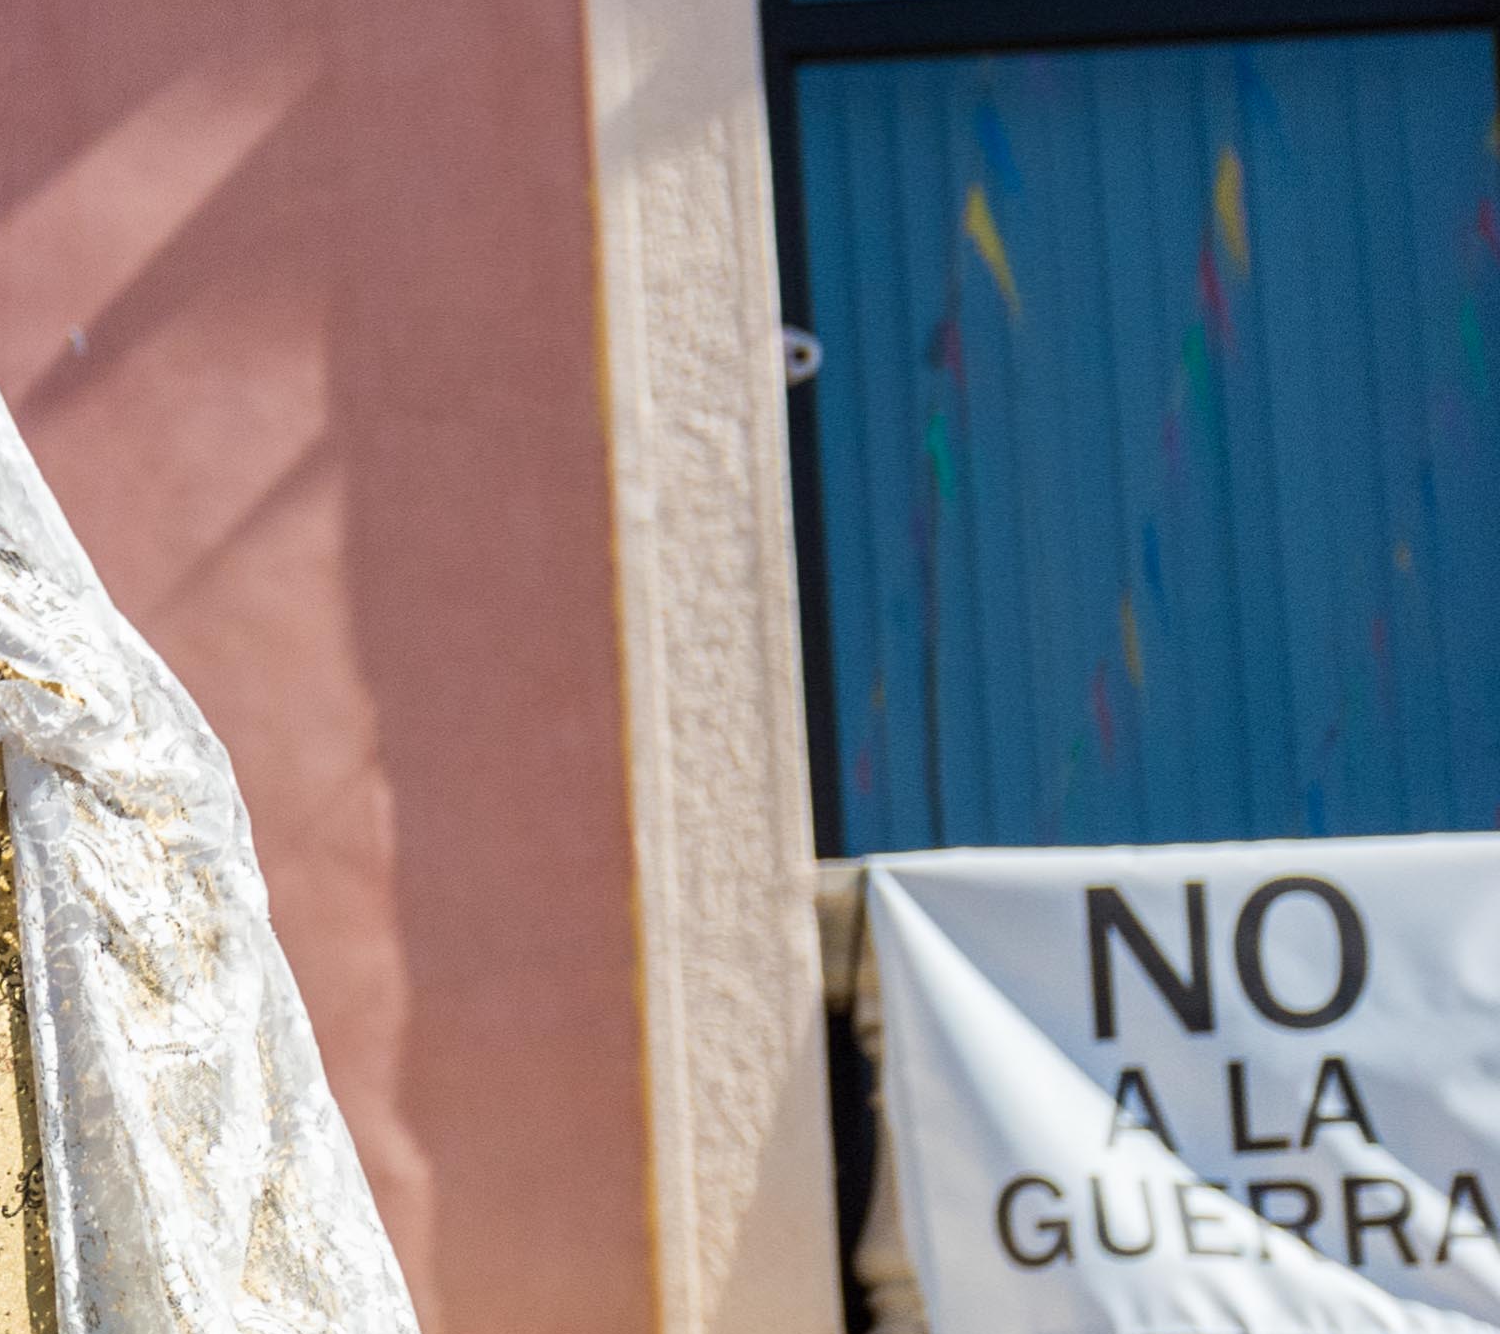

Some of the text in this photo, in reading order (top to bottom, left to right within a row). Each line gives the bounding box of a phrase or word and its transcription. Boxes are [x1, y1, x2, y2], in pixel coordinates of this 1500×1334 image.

[1085, 875, 1367, 1039] NO
[1108, 1056, 1378, 1155] A LA
[996, 1172, 1500, 1267] GUERRA
